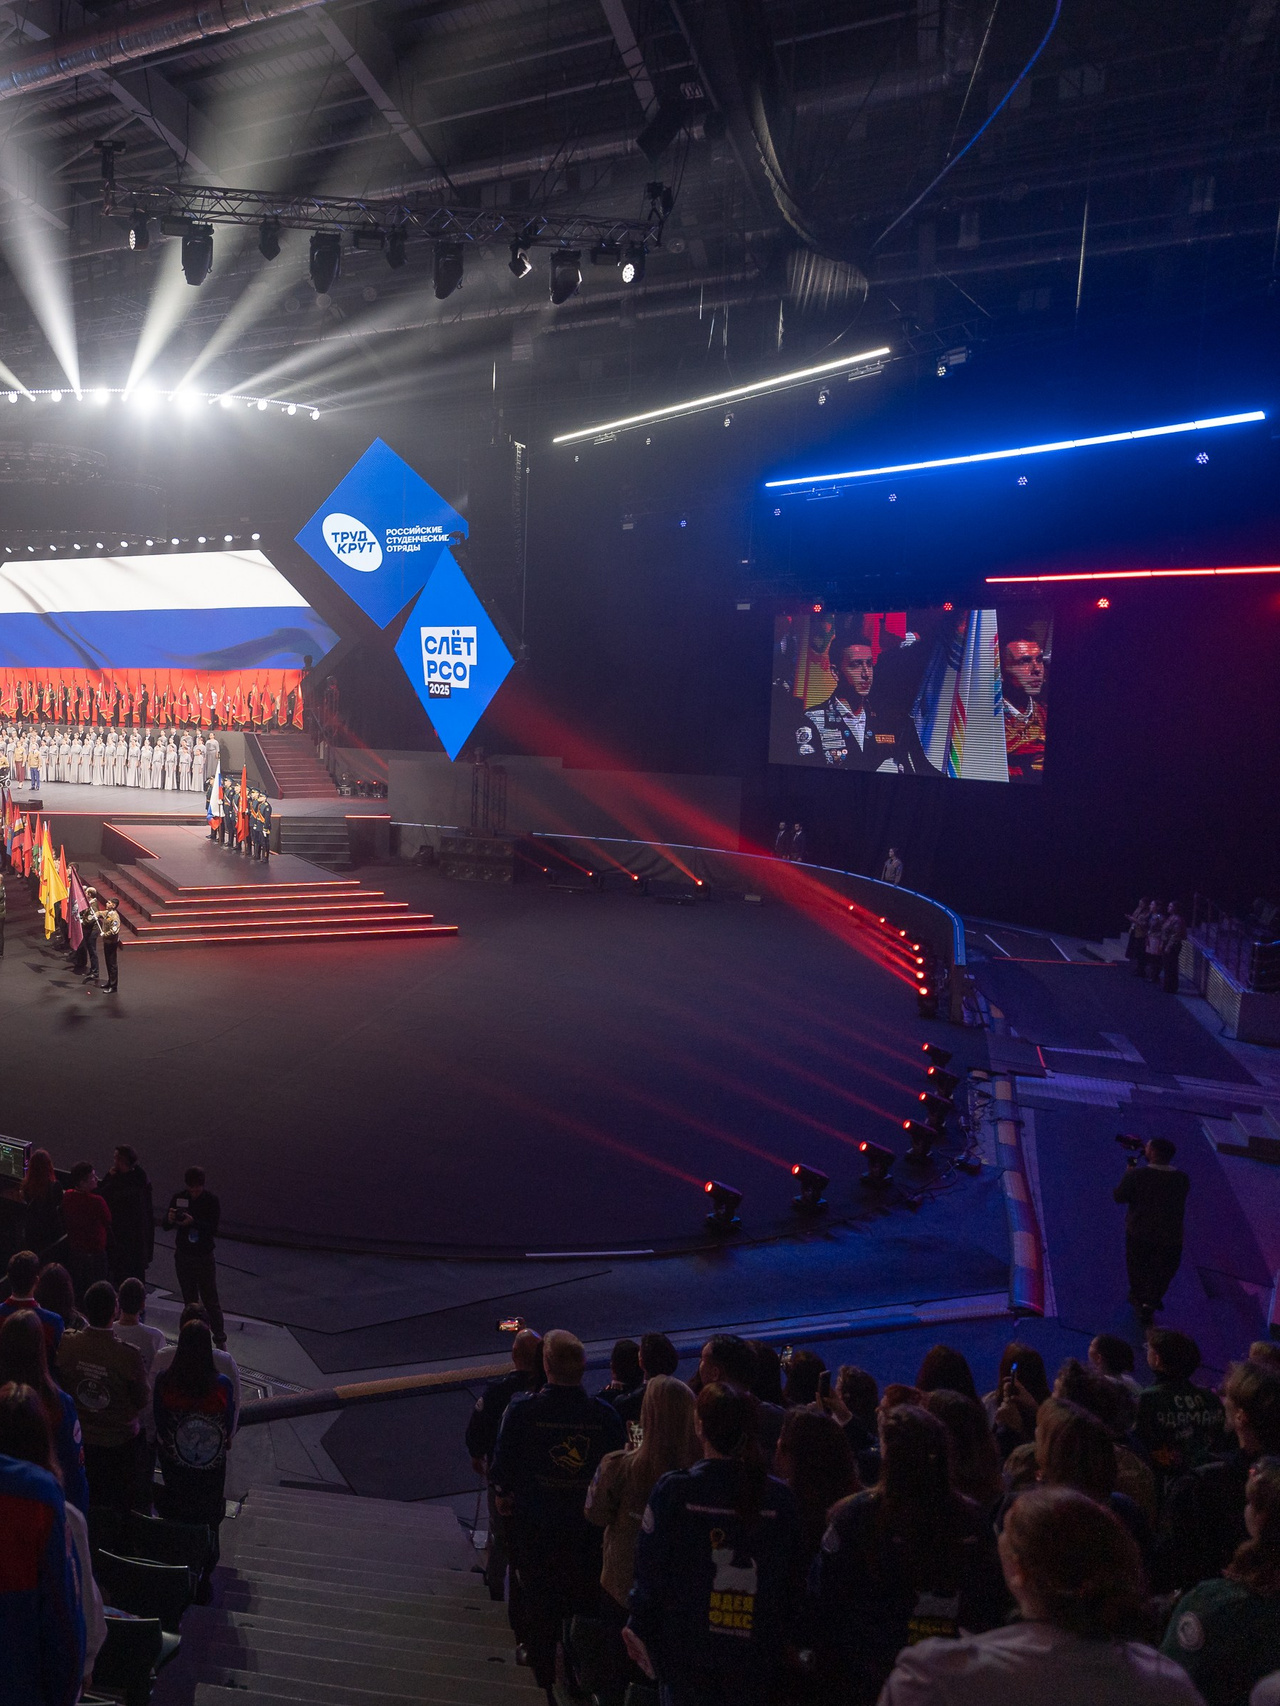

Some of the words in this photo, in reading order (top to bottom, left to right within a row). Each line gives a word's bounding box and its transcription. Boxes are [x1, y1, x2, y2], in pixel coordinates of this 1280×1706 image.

[386, 525, 443, 536] РОССИЙСКИЕ
[331, 531, 368, 543] ТРУД
[386, 534, 450, 544] СТУДЕНЧЕСКИЕ
[337, 542, 376, 554] КРУТ
[386, 544, 421, 553] ОТРЯДЫ
[424, 629, 475, 656] СЛЁТ
[427, 660, 468, 682] РСО
[429, 683, 450, 696] 2025
